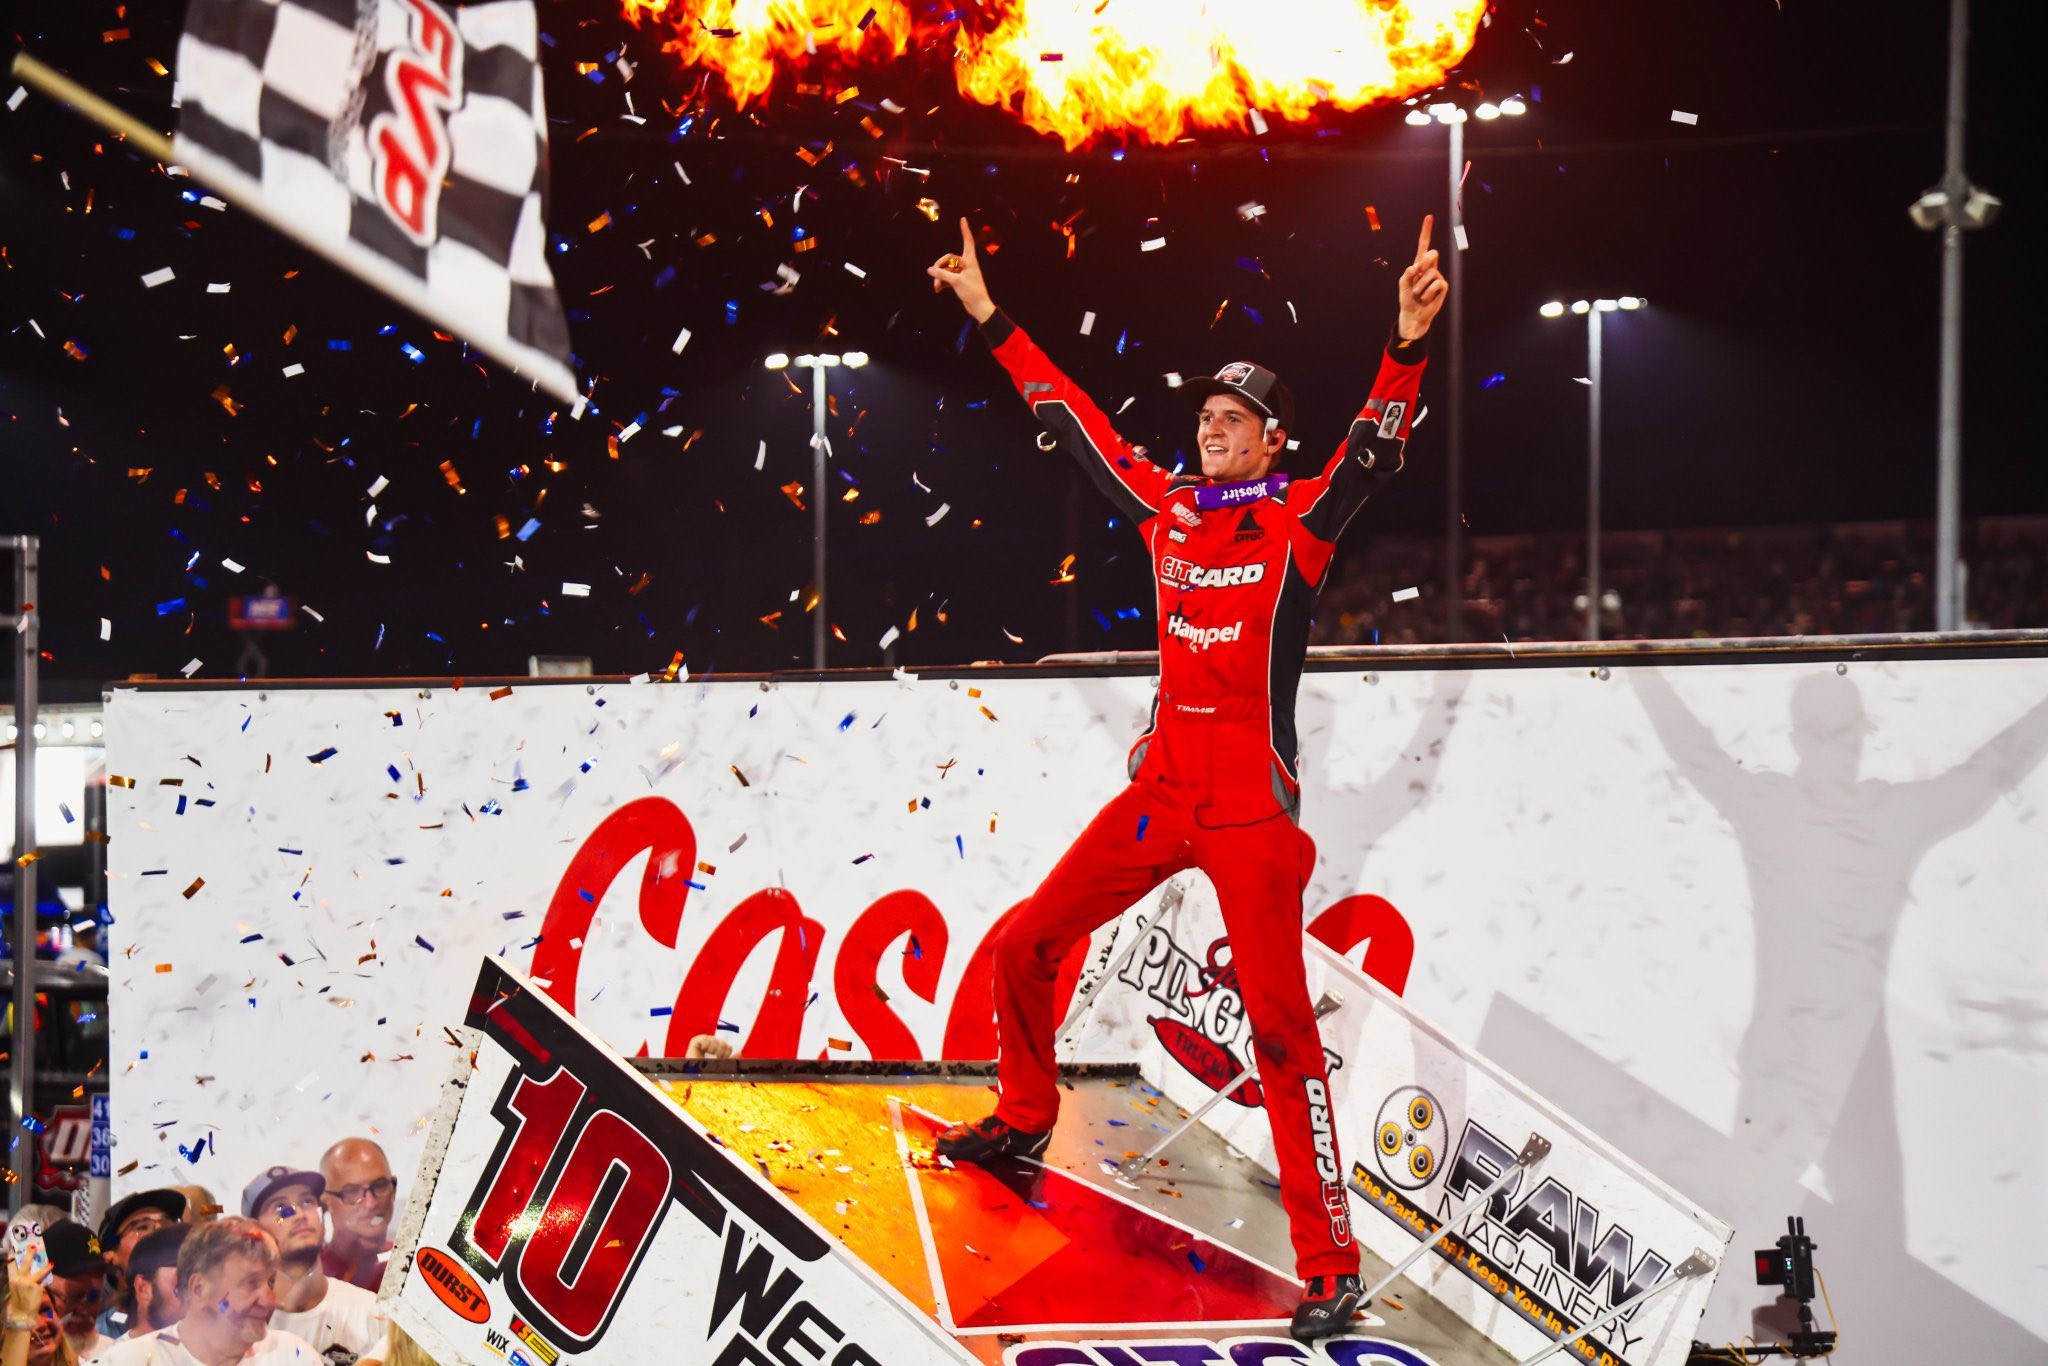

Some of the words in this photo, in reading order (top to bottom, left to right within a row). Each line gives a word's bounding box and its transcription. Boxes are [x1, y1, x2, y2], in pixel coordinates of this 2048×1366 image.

[1221, 482, 1268, 501] Hoosier
[1168, 614, 1243, 650] Hampel
[464, 1063, 673, 1344] 10
[1305, 1078, 1350, 1247] CITGARD
[1444, 1118, 1671, 1323] RAW
[420, 1252, 486, 1312] DURST
[1354, 1167, 1382, 1199] The
[1383, 1191, 1426, 1232] Parts
[1467, 1252, 1509, 1294] Keep
[1513, 1285, 1543, 1319] You
[1545, 1311, 1563, 1335] In
[1437, 1192, 1643, 1355] MACHINERY
[486, 1327, 510, 1353] WIX
